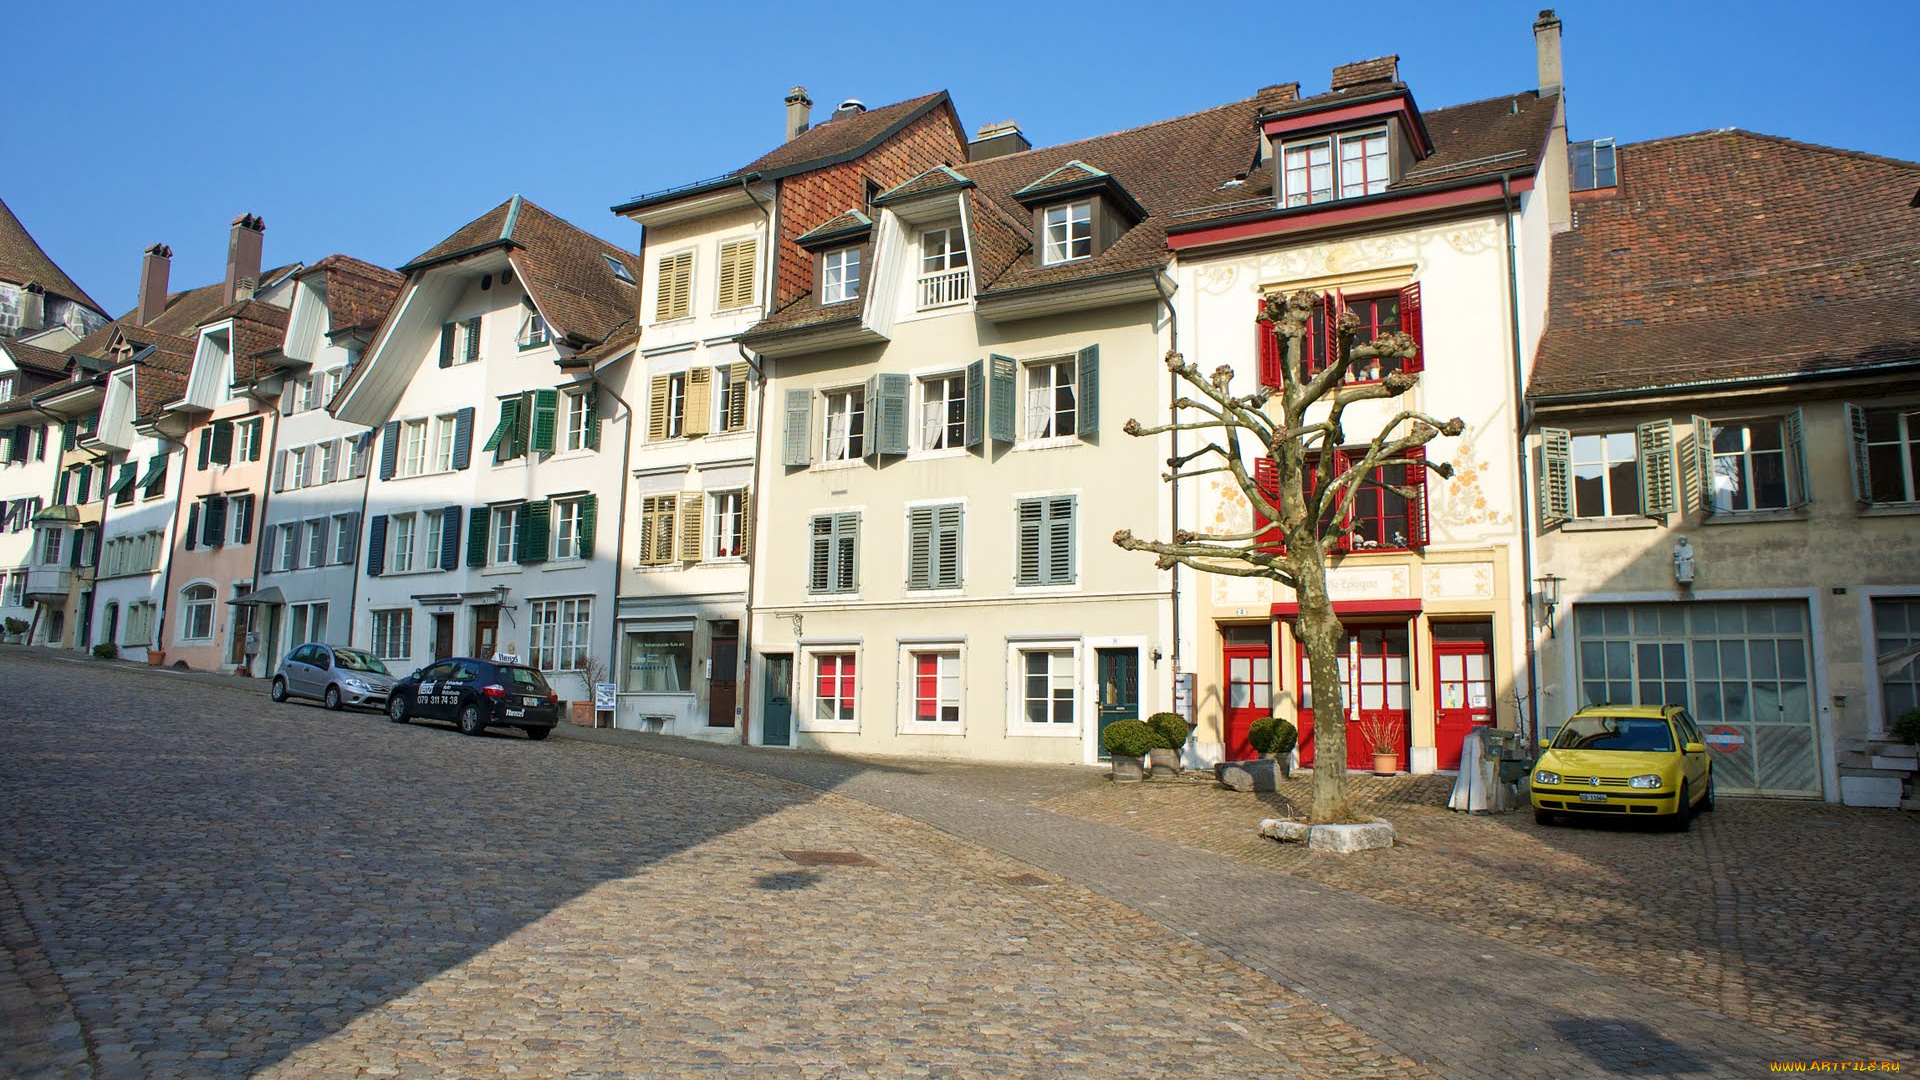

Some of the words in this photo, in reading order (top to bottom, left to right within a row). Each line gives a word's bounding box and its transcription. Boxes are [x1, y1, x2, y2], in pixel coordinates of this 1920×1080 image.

[417, 695, 429, 705] 079
[430, 695, 440, 705] 311
[441, 696, 448, 705] 74
[449, 696, 459, 706] 38
